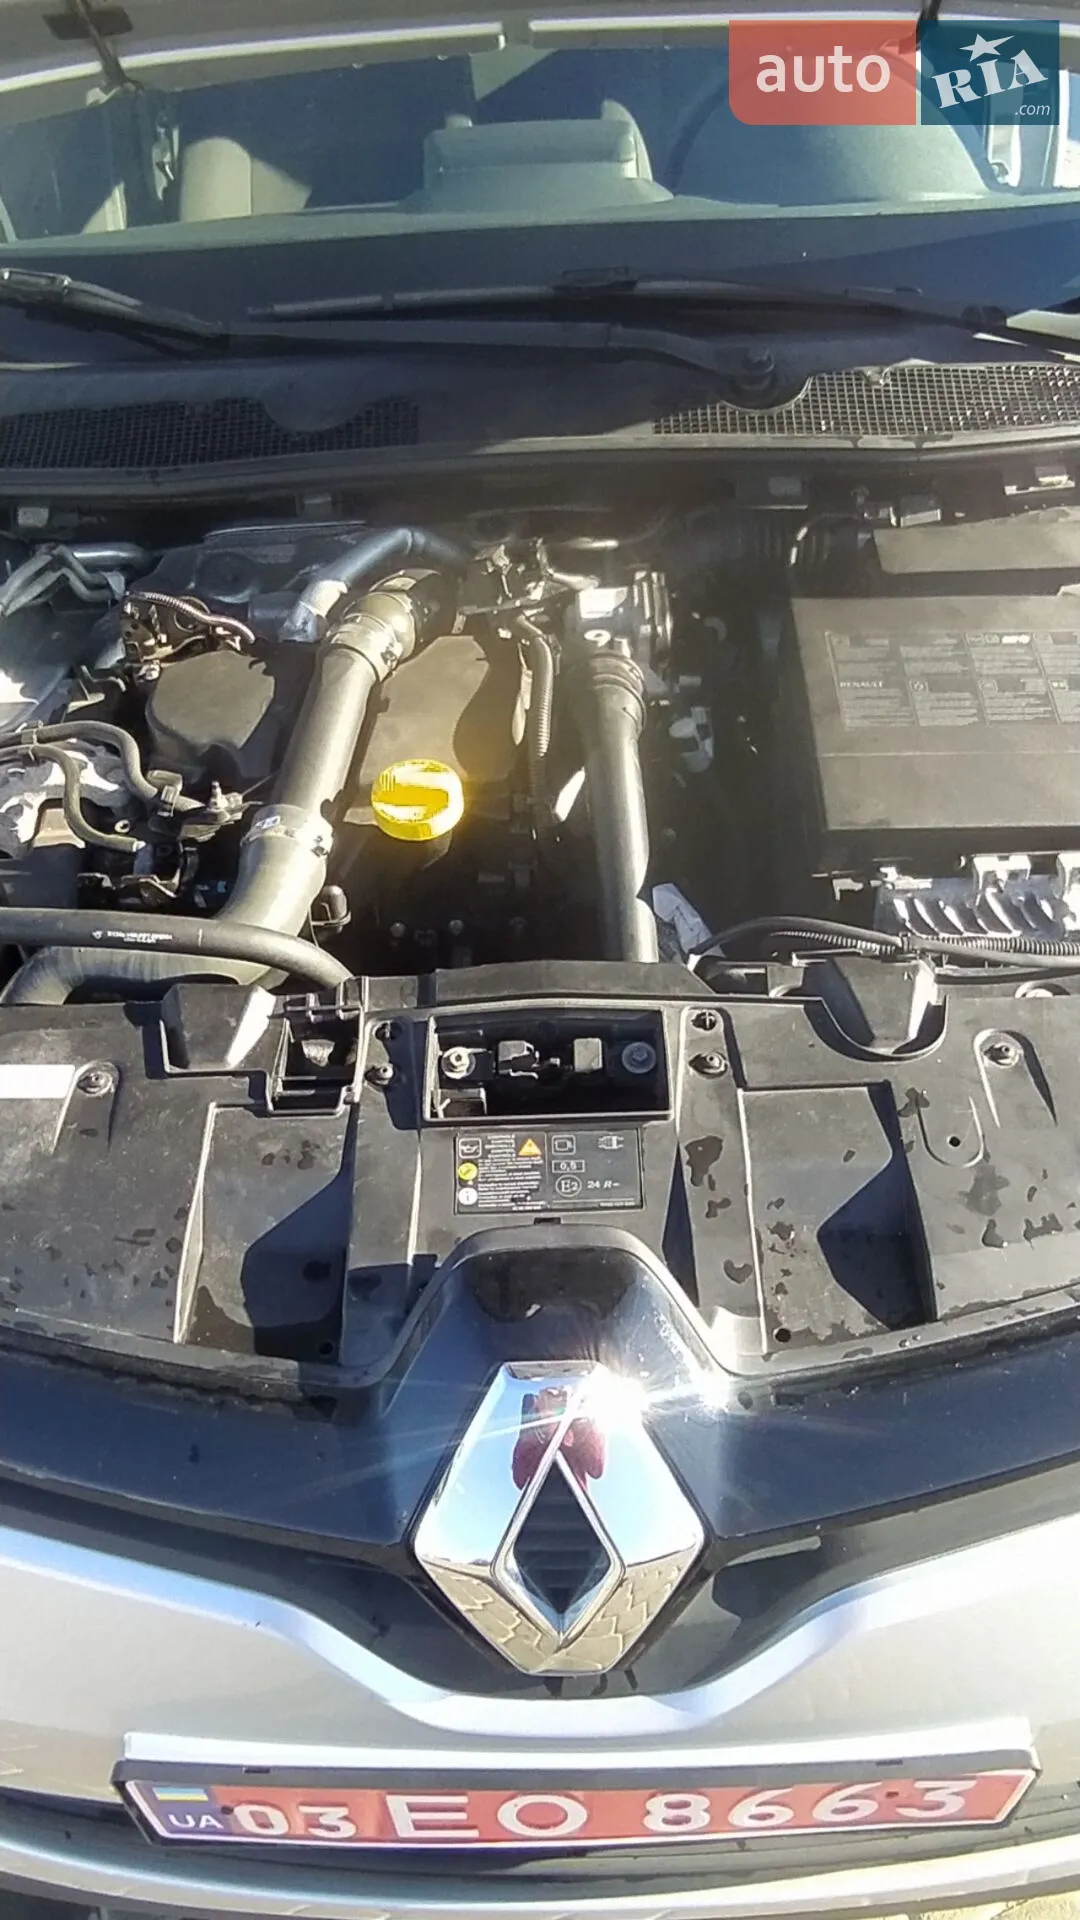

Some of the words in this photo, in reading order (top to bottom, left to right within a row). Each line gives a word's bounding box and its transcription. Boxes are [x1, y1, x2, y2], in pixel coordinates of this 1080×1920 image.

[168, 1813, 224, 1831] UA
[232, 1803, 358, 1839] 03
[386, 1792, 589, 1838] EO
[642, 1780, 978, 1833] 8663
